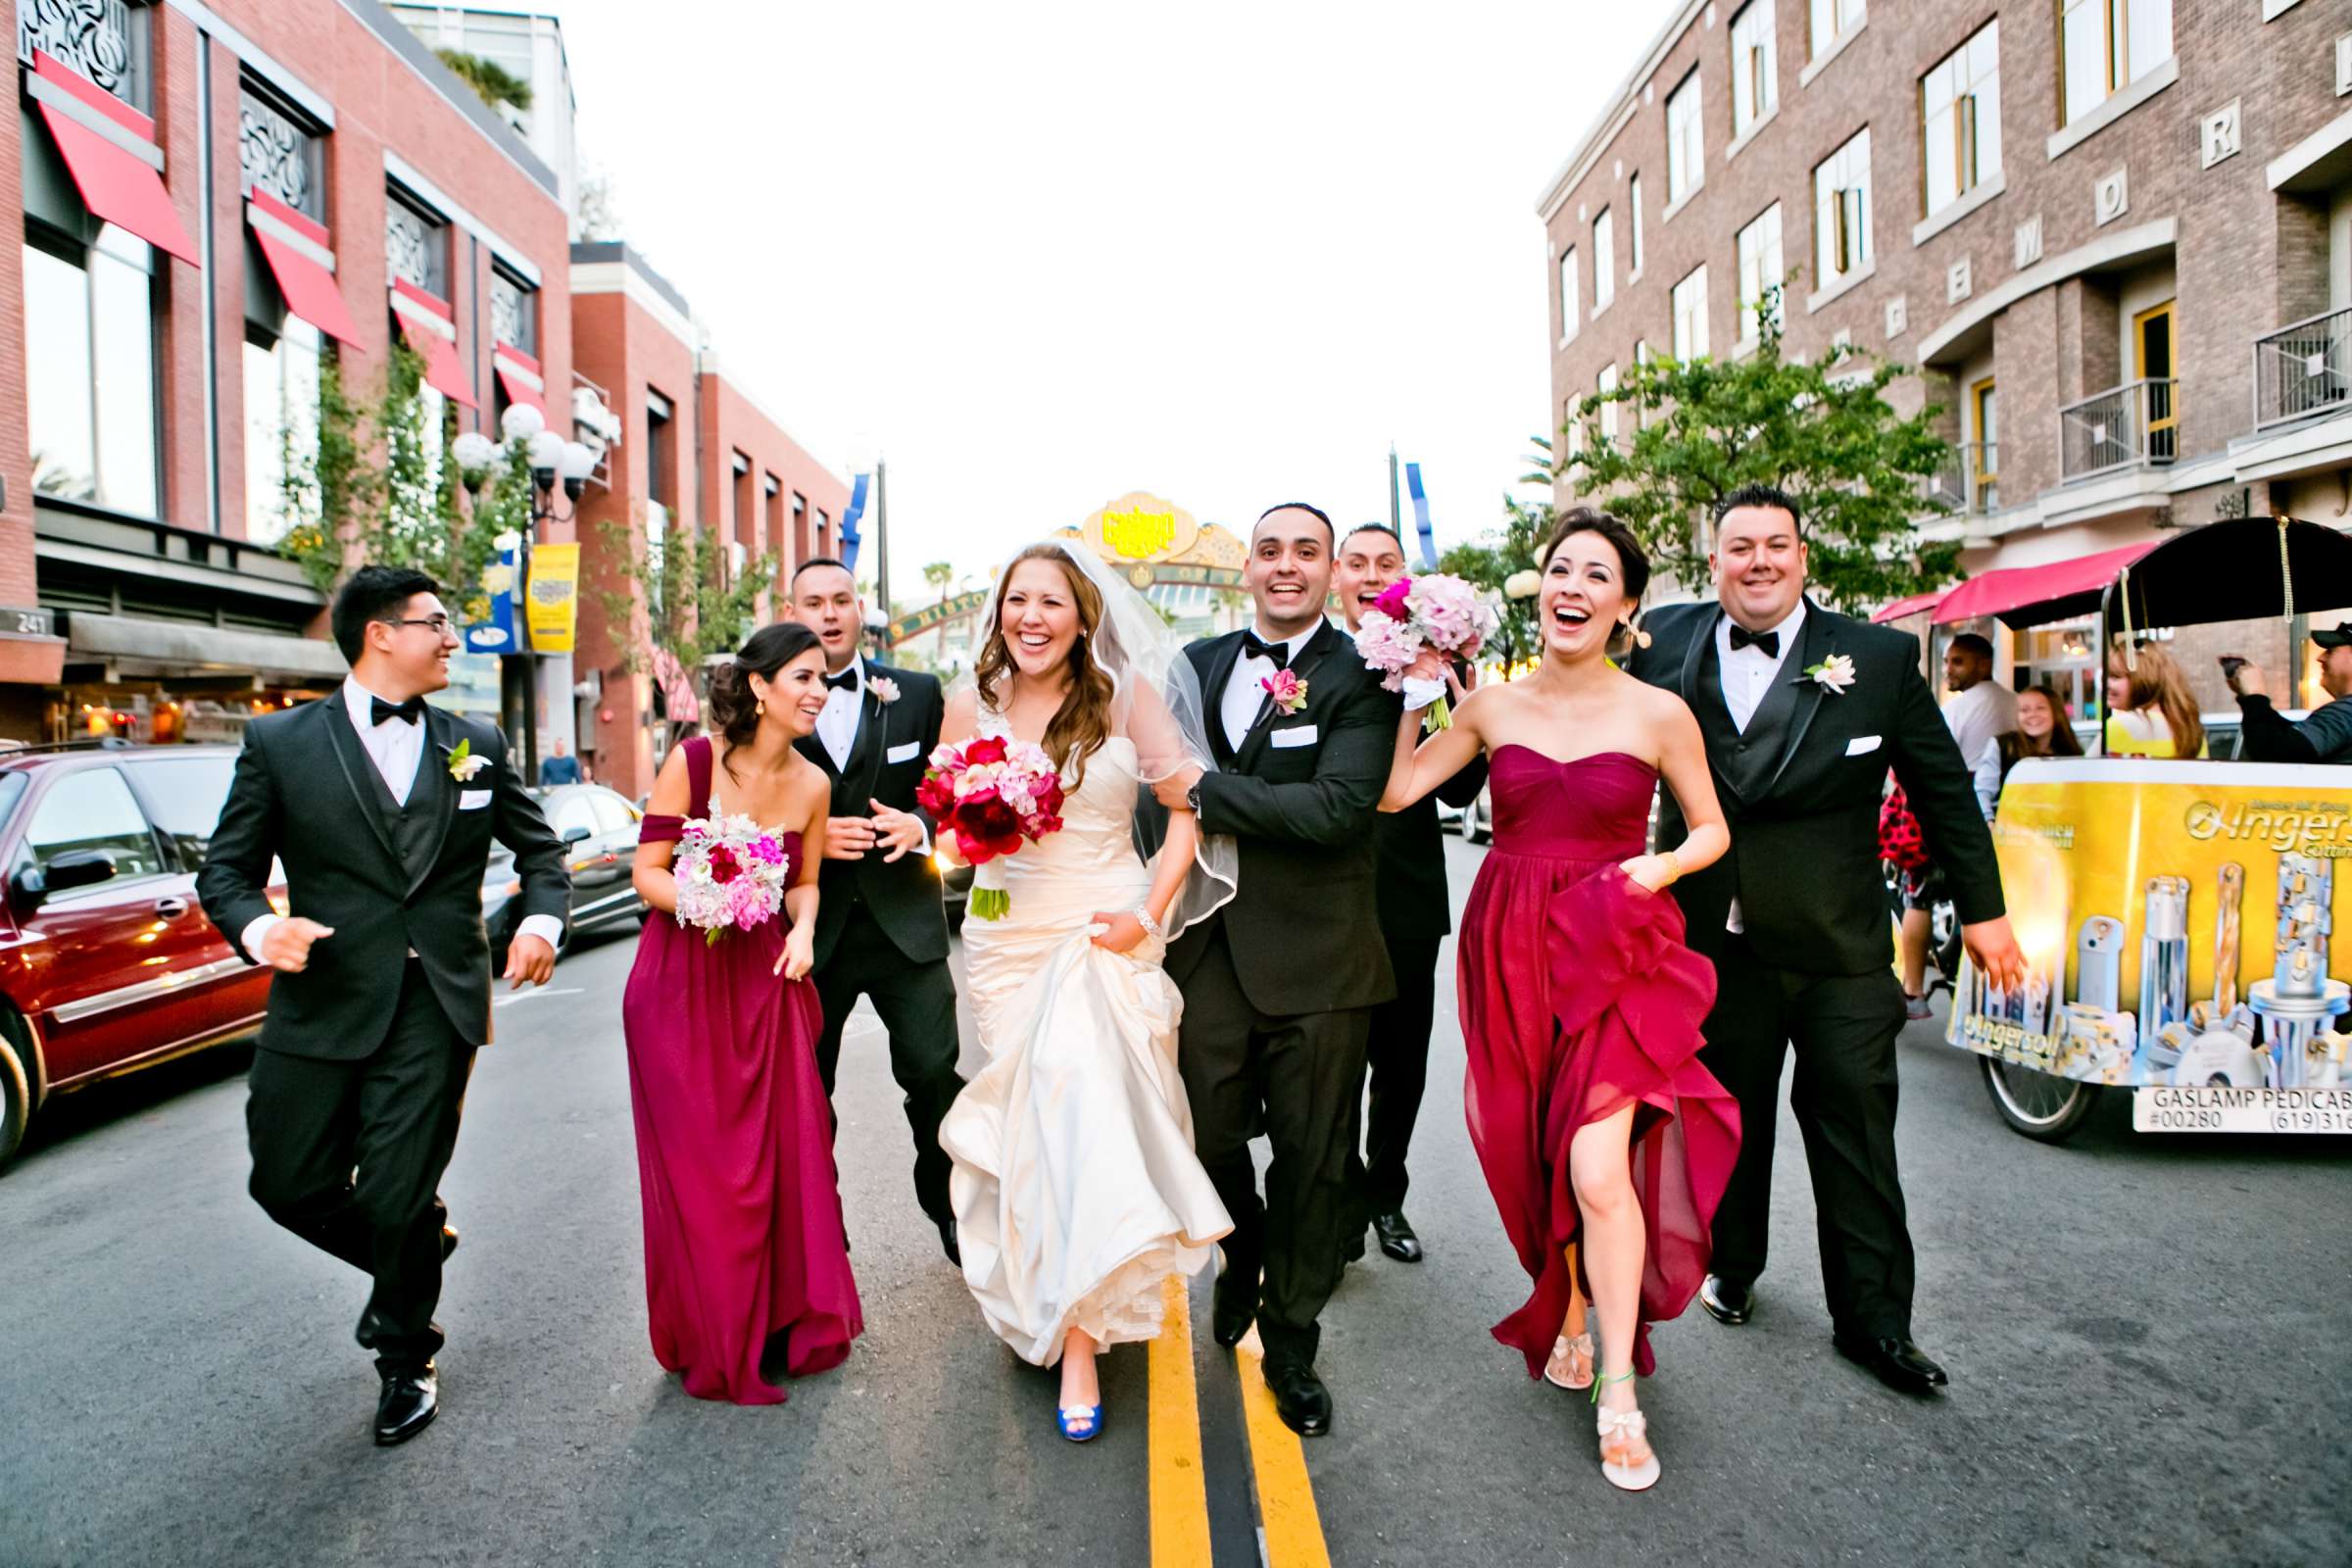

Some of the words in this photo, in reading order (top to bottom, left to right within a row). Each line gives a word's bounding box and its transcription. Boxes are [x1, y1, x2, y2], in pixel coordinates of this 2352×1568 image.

[2154, 1089, 2256, 1109] GASLAMP
[2262, 1090, 2352, 1110] PEDICAB
[2149, 1110, 2223, 1128] #00280
